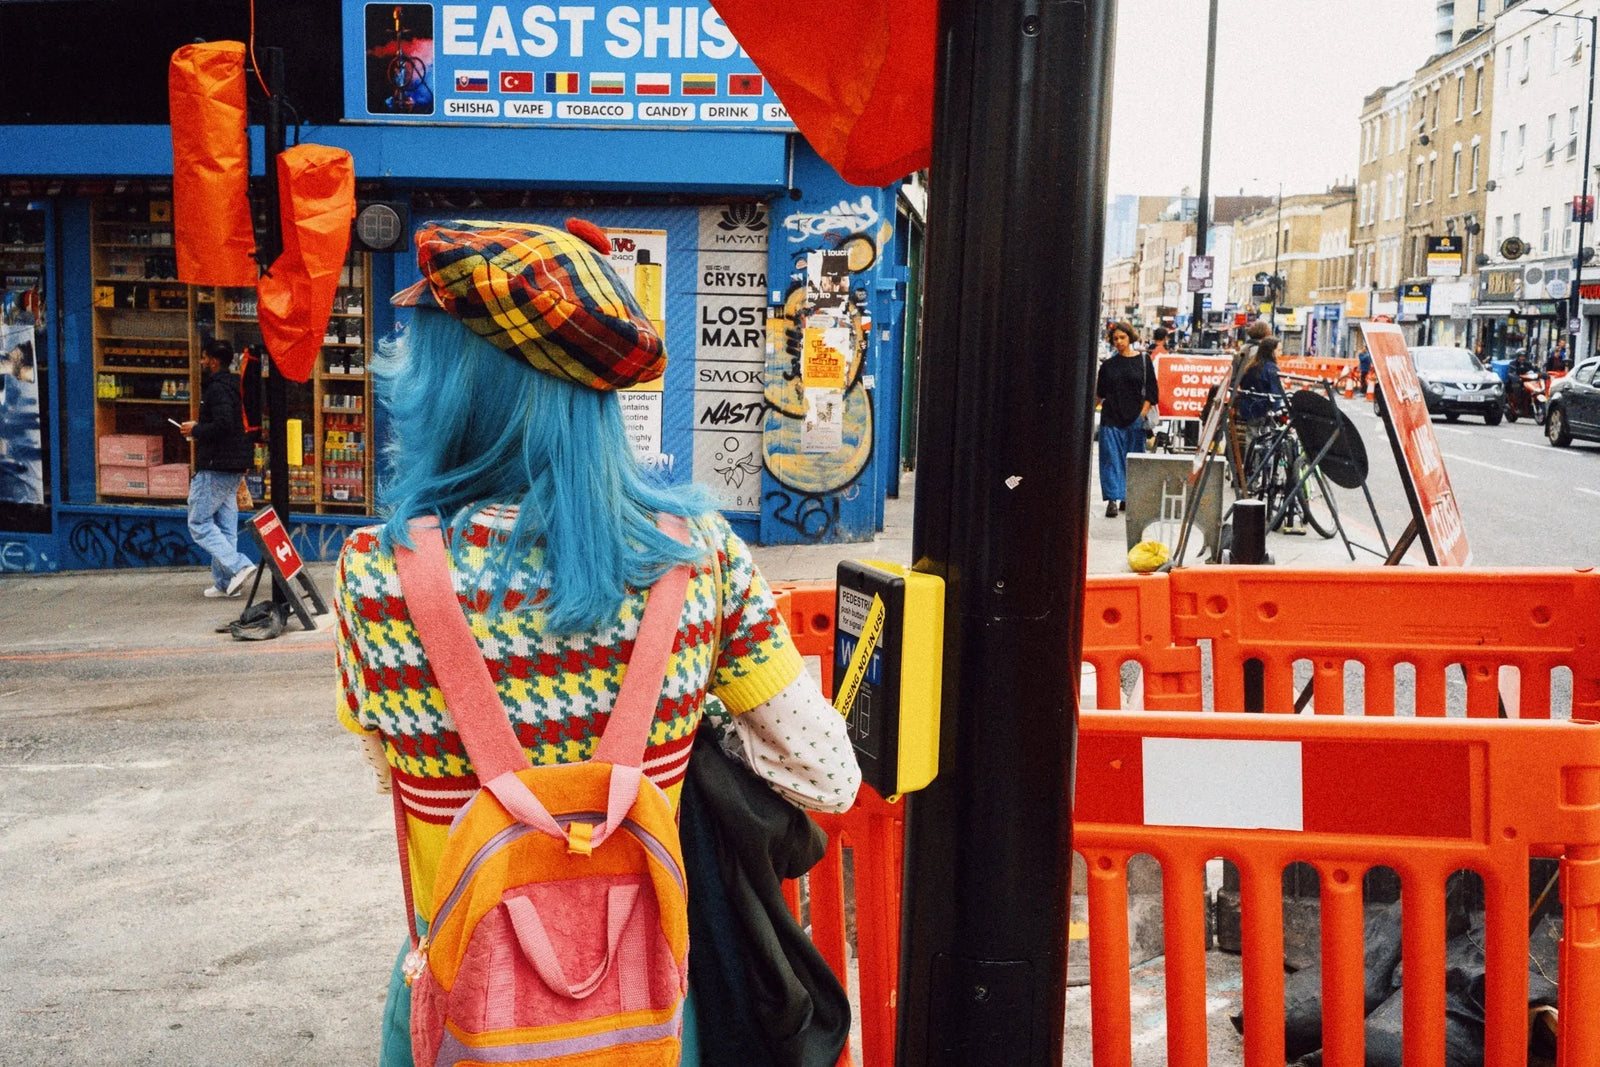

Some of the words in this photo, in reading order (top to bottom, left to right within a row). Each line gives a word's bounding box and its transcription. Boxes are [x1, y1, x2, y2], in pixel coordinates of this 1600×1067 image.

[442, 5, 595, 58] EAST
[604, 6, 751, 59] SHIS
[449, 102, 495, 114] SHISHA
[513, 103, 544, 115] VAPE
[566, 104, 625, 116] TOBACCO
[645, 105, 688, 117] CANDY
[708, 106, 749, 118] DRINK
[770, 107, 790, 118] SN
[703, 271, 768, 288] CRYSTA
[702, 305, 767, 326] LOST
[1170, 364, 1212, 373] NARROW
[699, 368, 765, 385] SMOK
[1181, 374, 1200, 385] DO
[1173, 401, 1206, 411] CYCL
[700, 399, 767, 426] NASTY
[841, 638, 880, 681] WT
[841, 673, 860, 717] OSSING
[857, 646, 870, 675] NOT
[867, 631, 876, 649] IN
[873, 605, 885, 633] USE
